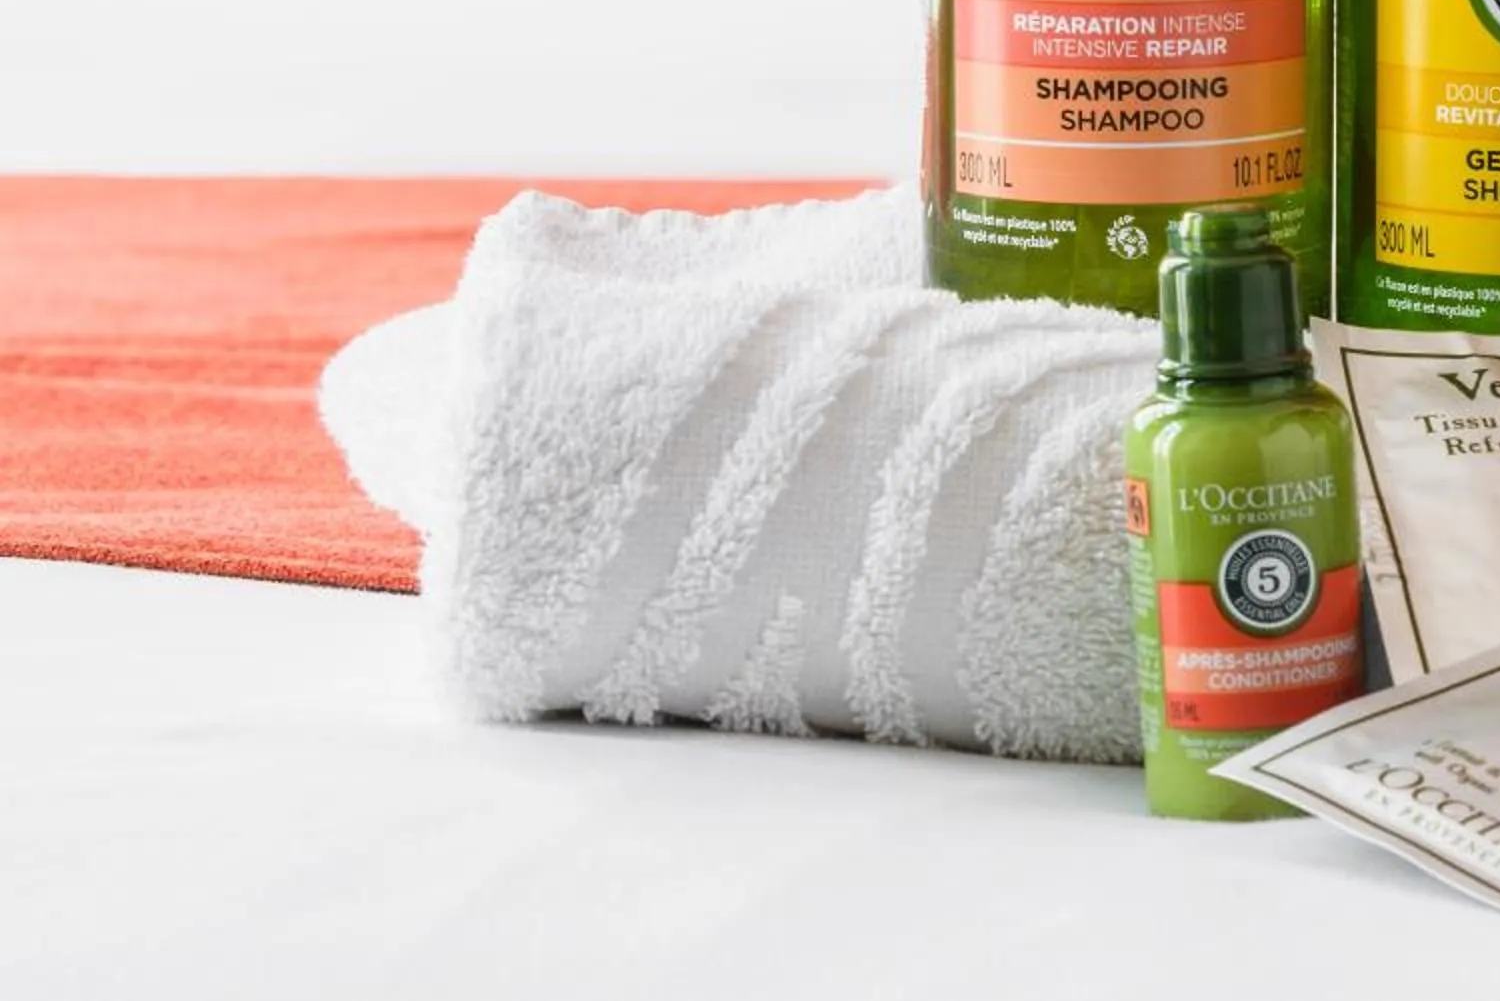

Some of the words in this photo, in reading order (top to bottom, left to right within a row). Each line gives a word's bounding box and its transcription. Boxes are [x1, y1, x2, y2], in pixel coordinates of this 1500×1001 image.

[1013, 9, 1156, 35] RÉPARATION
[1162, 11, 1246, 33] INTENSE
[1032, 39, 1138, 59] INTENSIVE
[1145, 37, 1228, 58] REPAIR
[1036, 76, 1228, 101] SHAMPOOING
[1060, 108, 1204, 132] SHAMPOO
[958, 151, 983, 183] 300
[987, 156, 1013, 189] ML
[1233, 157, 1262, 188] 10.1
[1379, 221, 1405, 252] 300
[1411, 226, 1435, 258] ML
[1414, 413, 1497, 435] Tissu
[1211, 512, 1233, 526] EN
[1237, 506, 1315, 525] PROVENCE
[1259, 566, 1280, 593] 5
[1209, 661, 1339, 690] CONDITIONER
